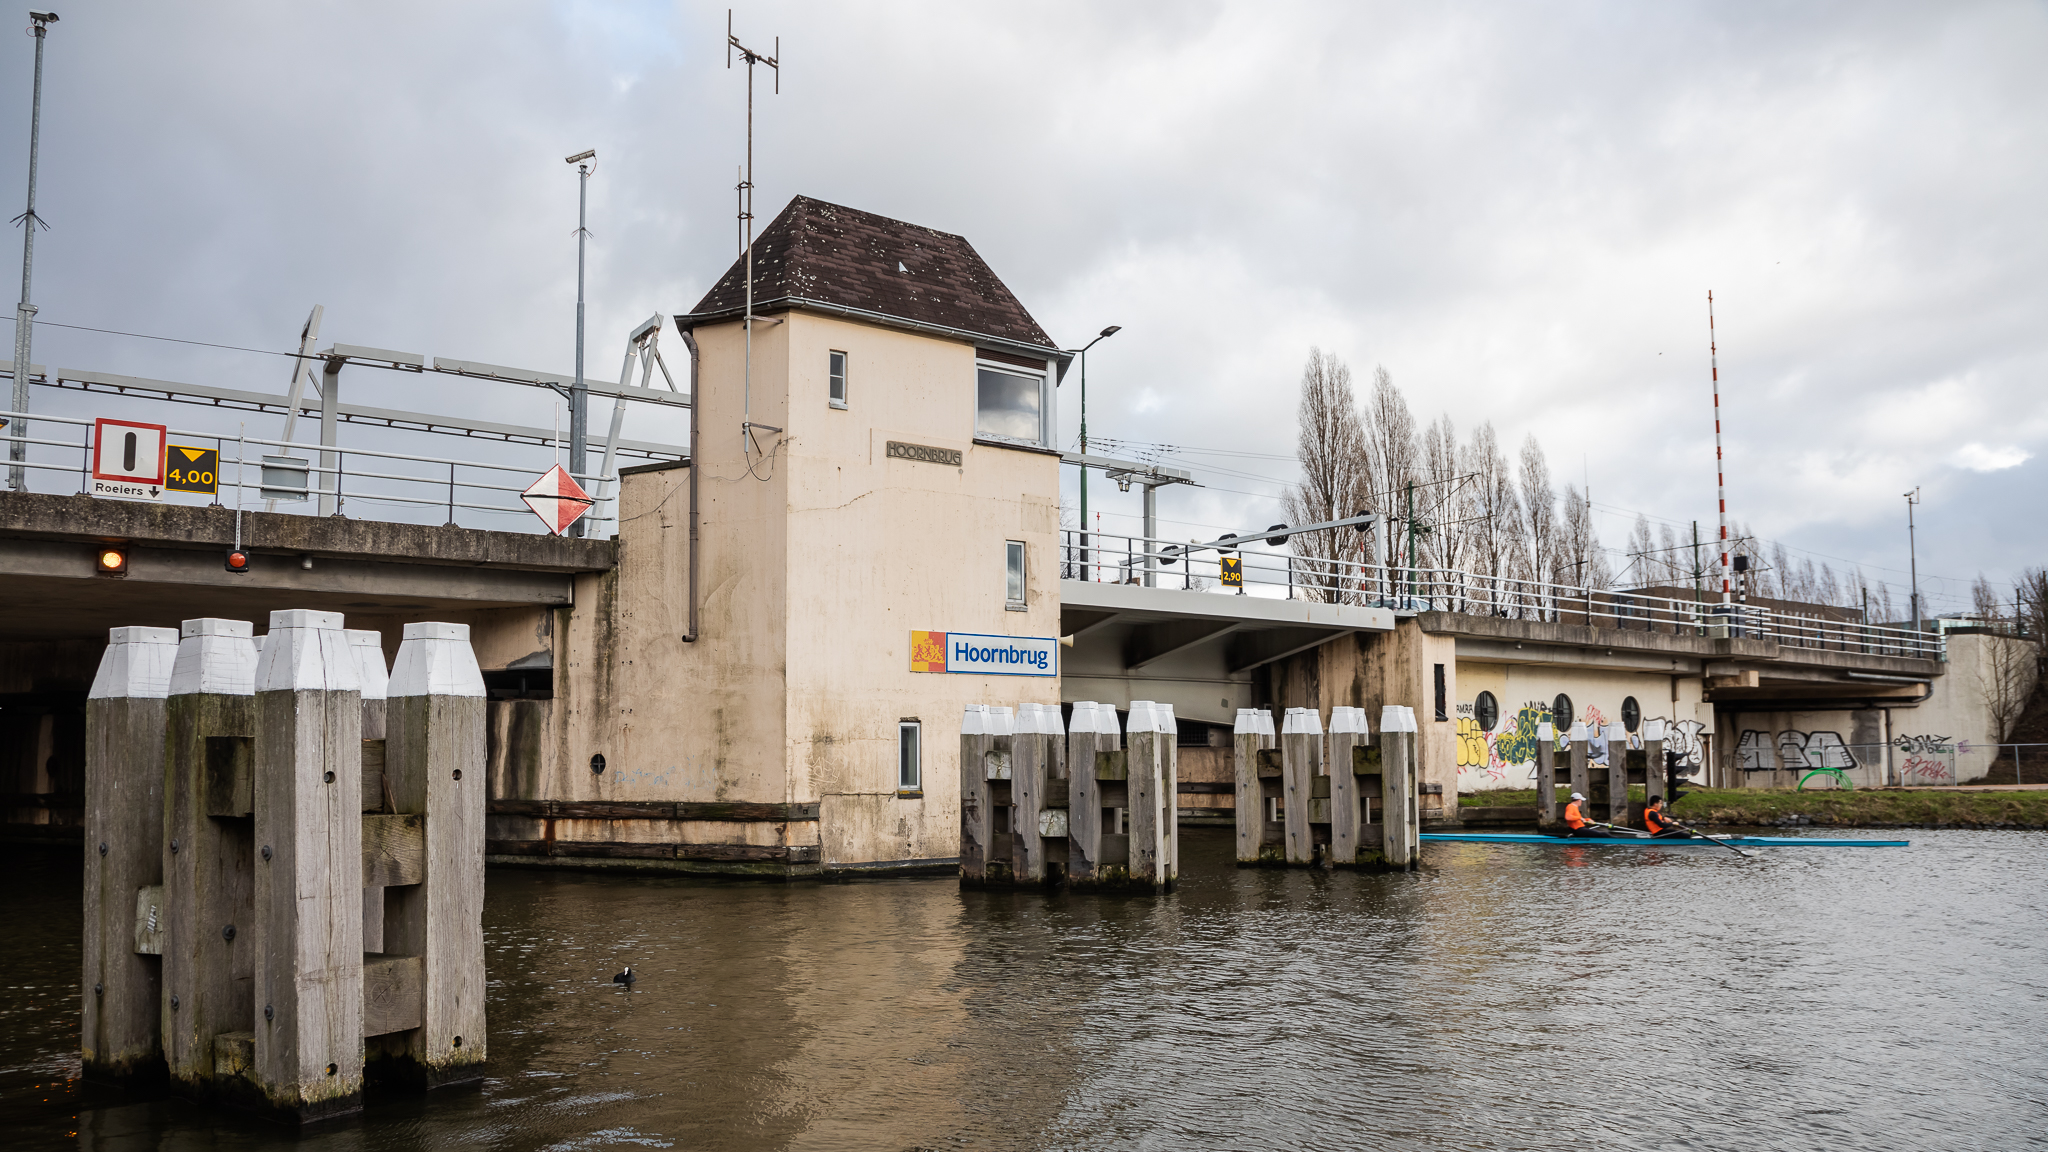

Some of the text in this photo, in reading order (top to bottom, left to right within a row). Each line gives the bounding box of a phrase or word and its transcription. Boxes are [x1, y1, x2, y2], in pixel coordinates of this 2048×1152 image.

[888, 443, 961, 464] HOORNBRUG
[168, 468, 214, 485] 4,00
[95, 482, 144, 496] Roeiers
[1223, 571, 1241, 582] 2,90
[956, 642, 1048, 669] Hoornbrug
